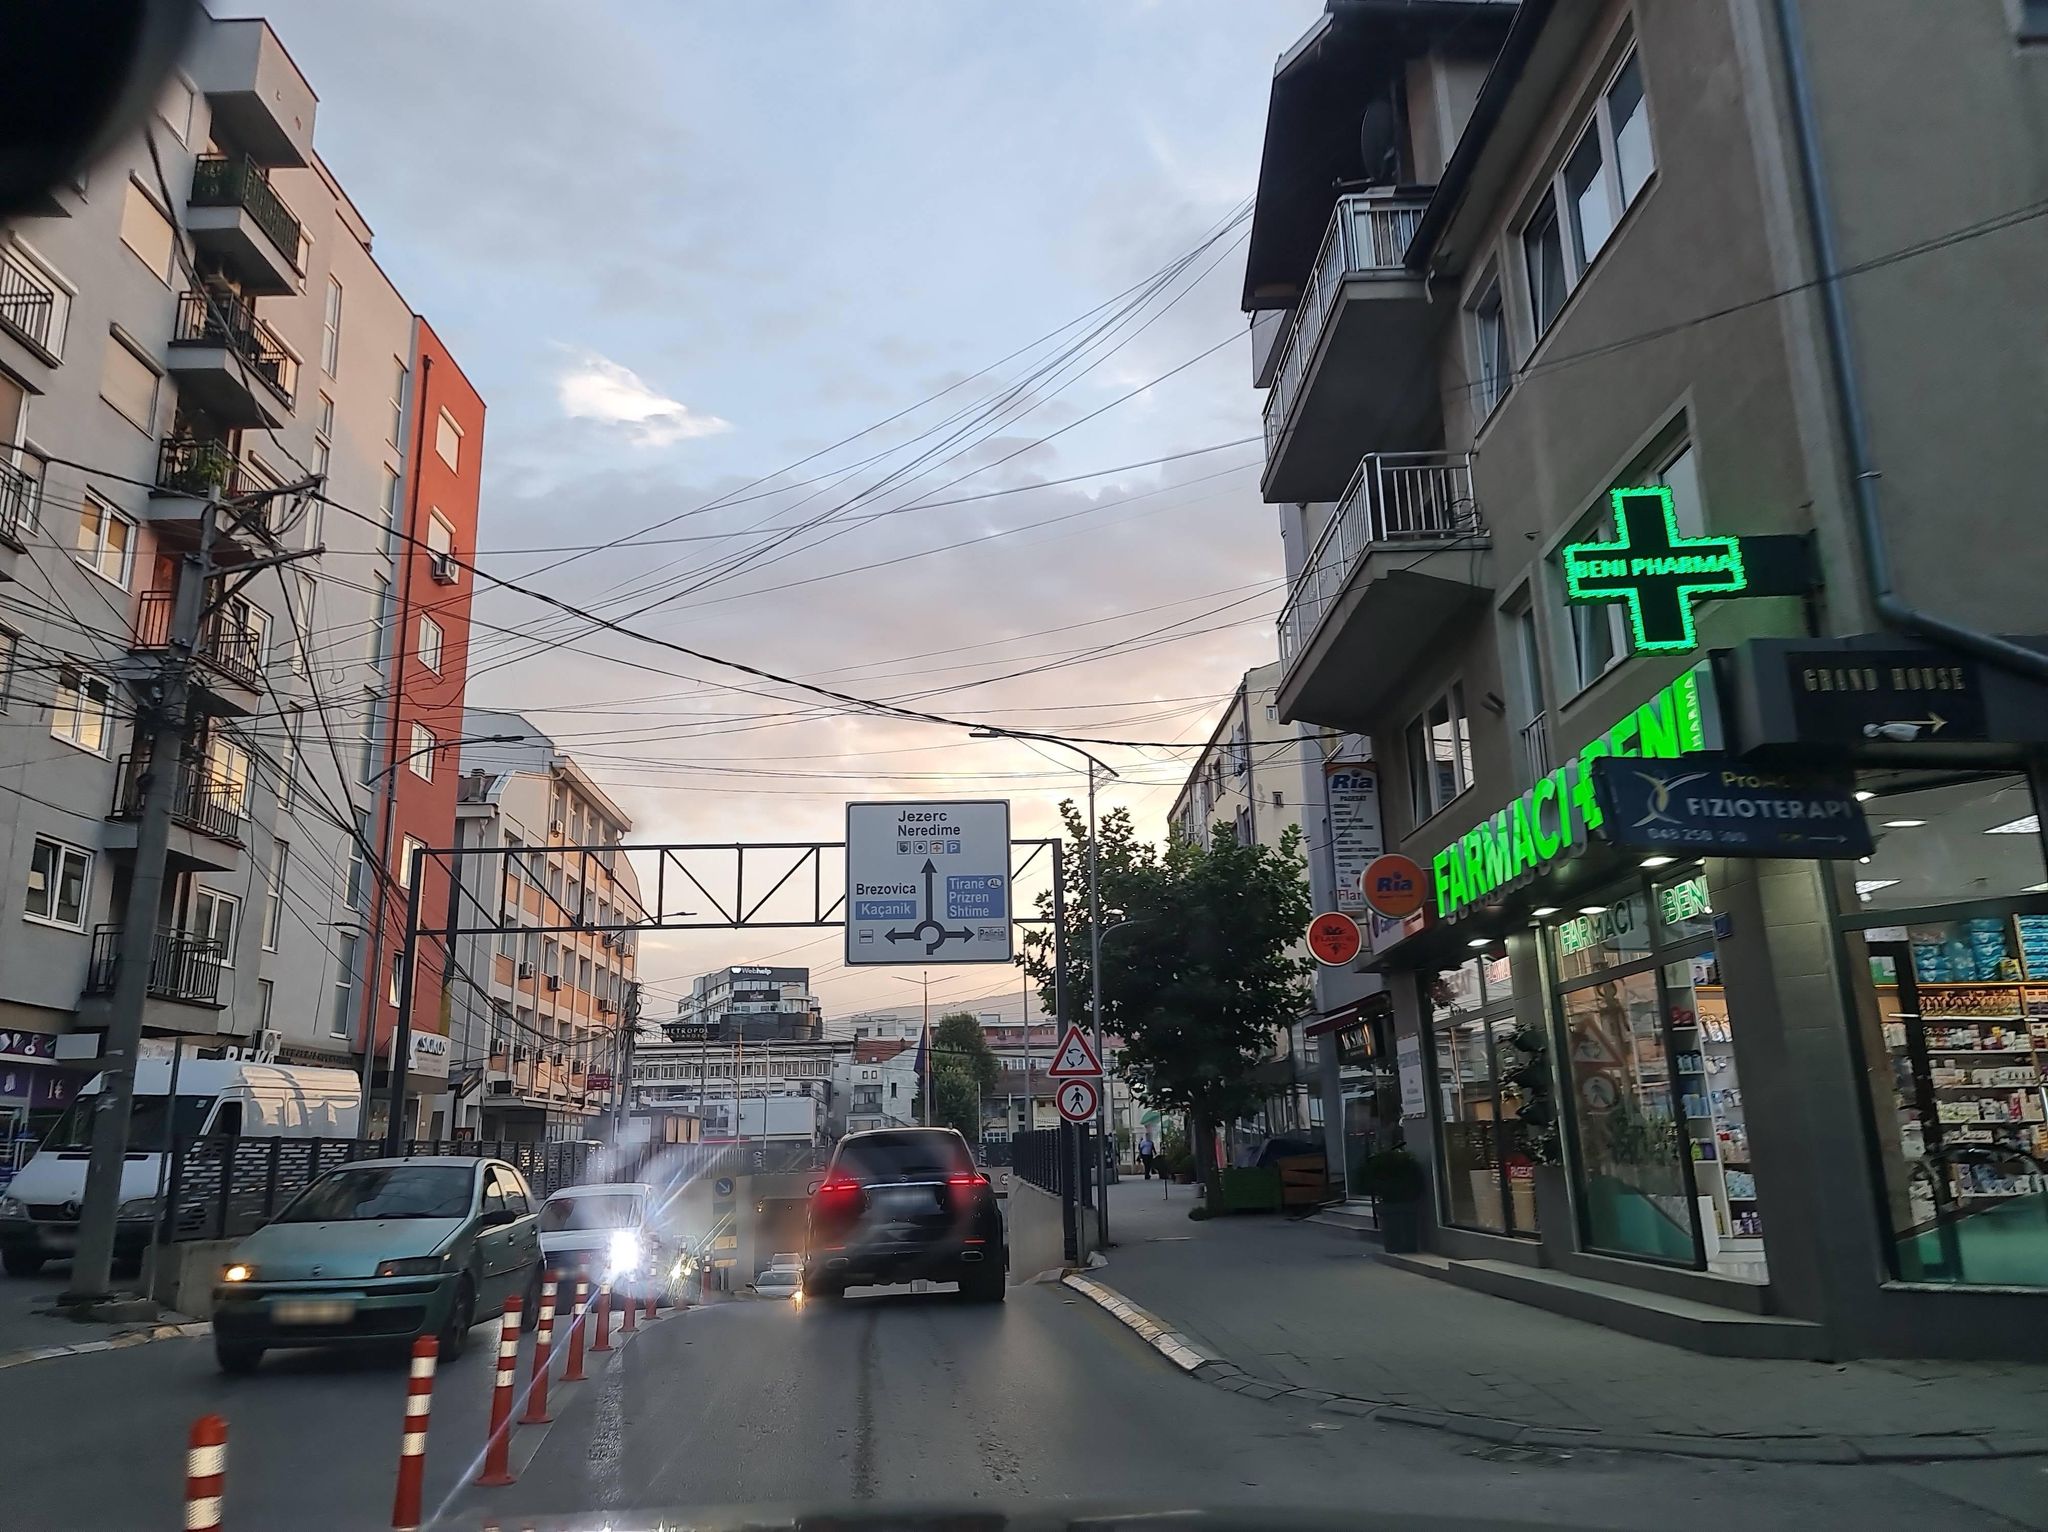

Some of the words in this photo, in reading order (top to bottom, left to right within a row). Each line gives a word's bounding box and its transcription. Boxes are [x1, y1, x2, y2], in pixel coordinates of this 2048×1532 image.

[1684, 676, 1701, 748] HARMA
[1331, 769, 1374, 789] Ria
[1686, 797, 1853, 819] FIZIOTERAPI
[898, 810, 948, 822] Jezerc
[898, 824, 961, 837] Neredime
[1432, 766, 1572, 919] FARMACI
[1377, 871, 1413, 892] Ria
[856, 883, 917, 896] Brezovica
[949, 891, 989, 903] Prizren
[861, 902, 911, 917] Kaçanik
[949, 905, 990, 917] Shtime
[1559, 899, 1635, 957] FARMACI
[741, 967, 772, 976] Webhelp
